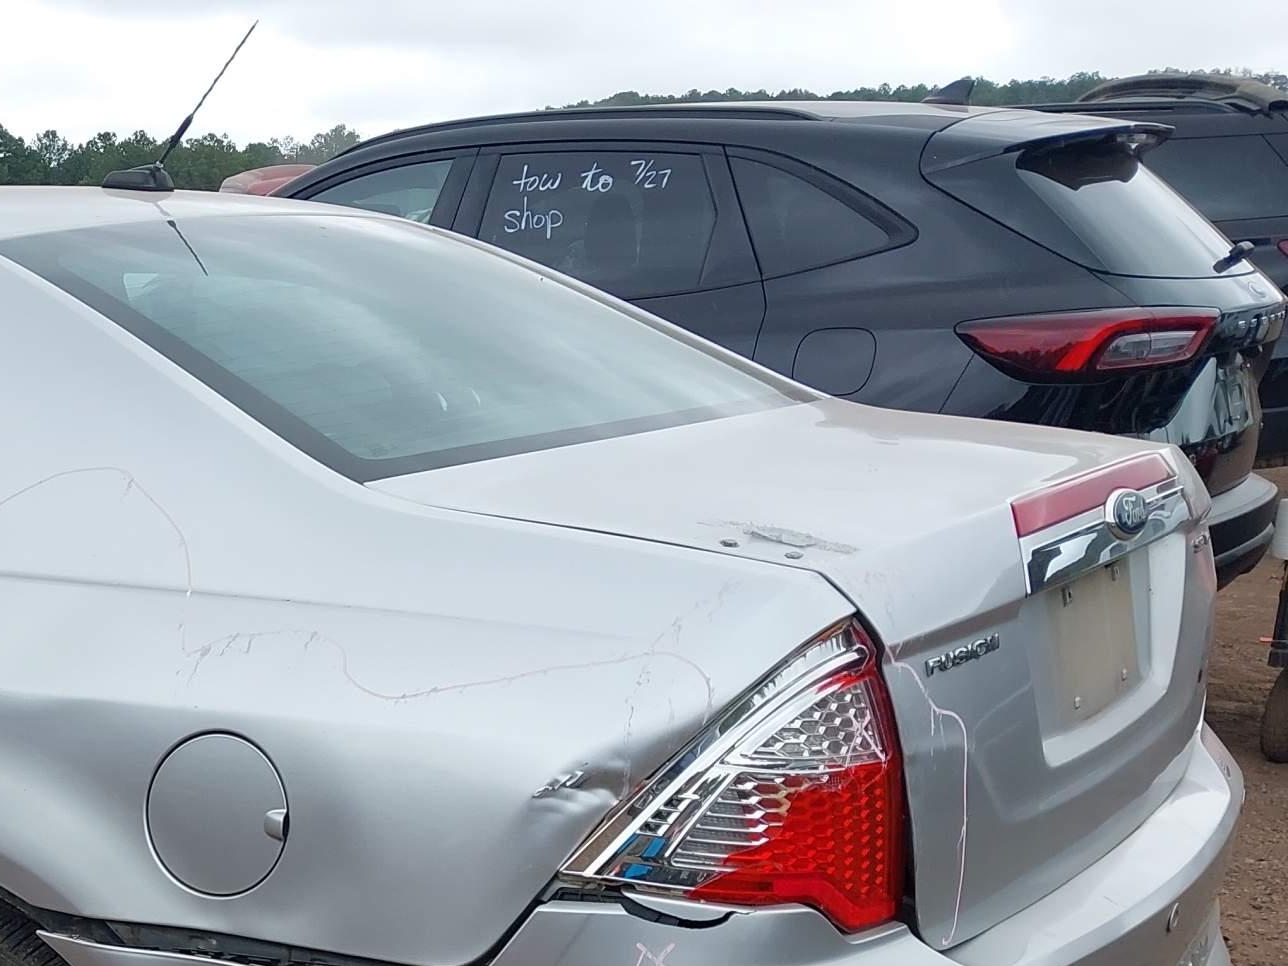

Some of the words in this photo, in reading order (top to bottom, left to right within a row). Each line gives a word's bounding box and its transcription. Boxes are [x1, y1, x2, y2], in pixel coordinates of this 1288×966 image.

[512, 164, 563, 193] tow
[581, 162, 614, 193] to
[630, 159, 672, 189] 7/27
[503, 196, 563, 240] shop
[925, 632, 1000, 677] FUSION
